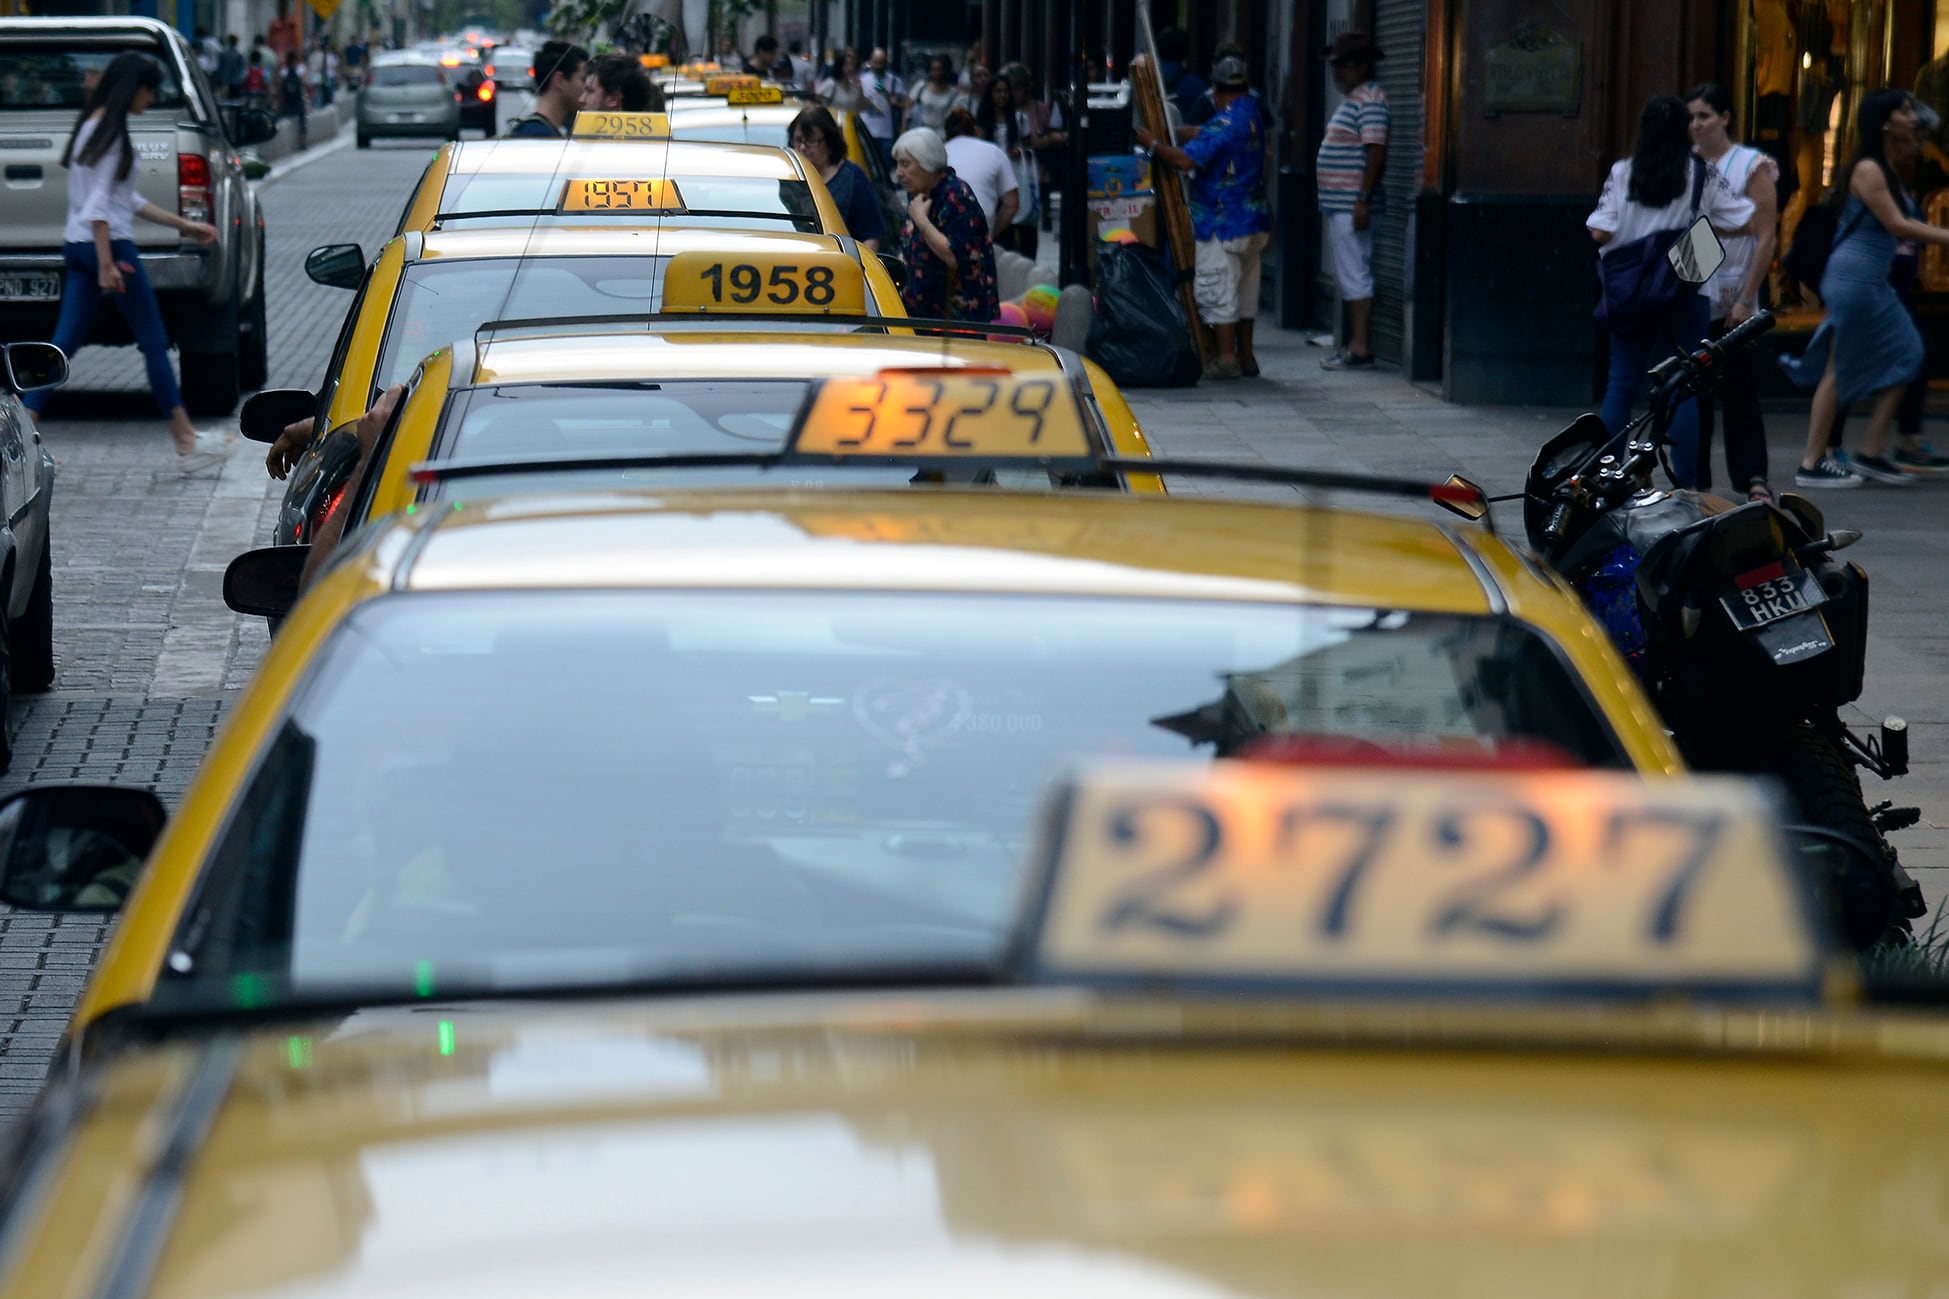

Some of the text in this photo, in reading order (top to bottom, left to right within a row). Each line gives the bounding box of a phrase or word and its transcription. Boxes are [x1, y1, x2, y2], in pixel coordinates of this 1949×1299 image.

[594, 116, 653, 136] 2958
[584, 180, 653, 208] 1957
[30, 279, 56, 296] 927
[700, 263, 836, 305] 1958
[837, 379, 1056, 449] 3329
[1742, 577, 1795, 604] 833
[1750, 591, 1807, 621] HKU
[1103, 798, 1724, 943] 2727
